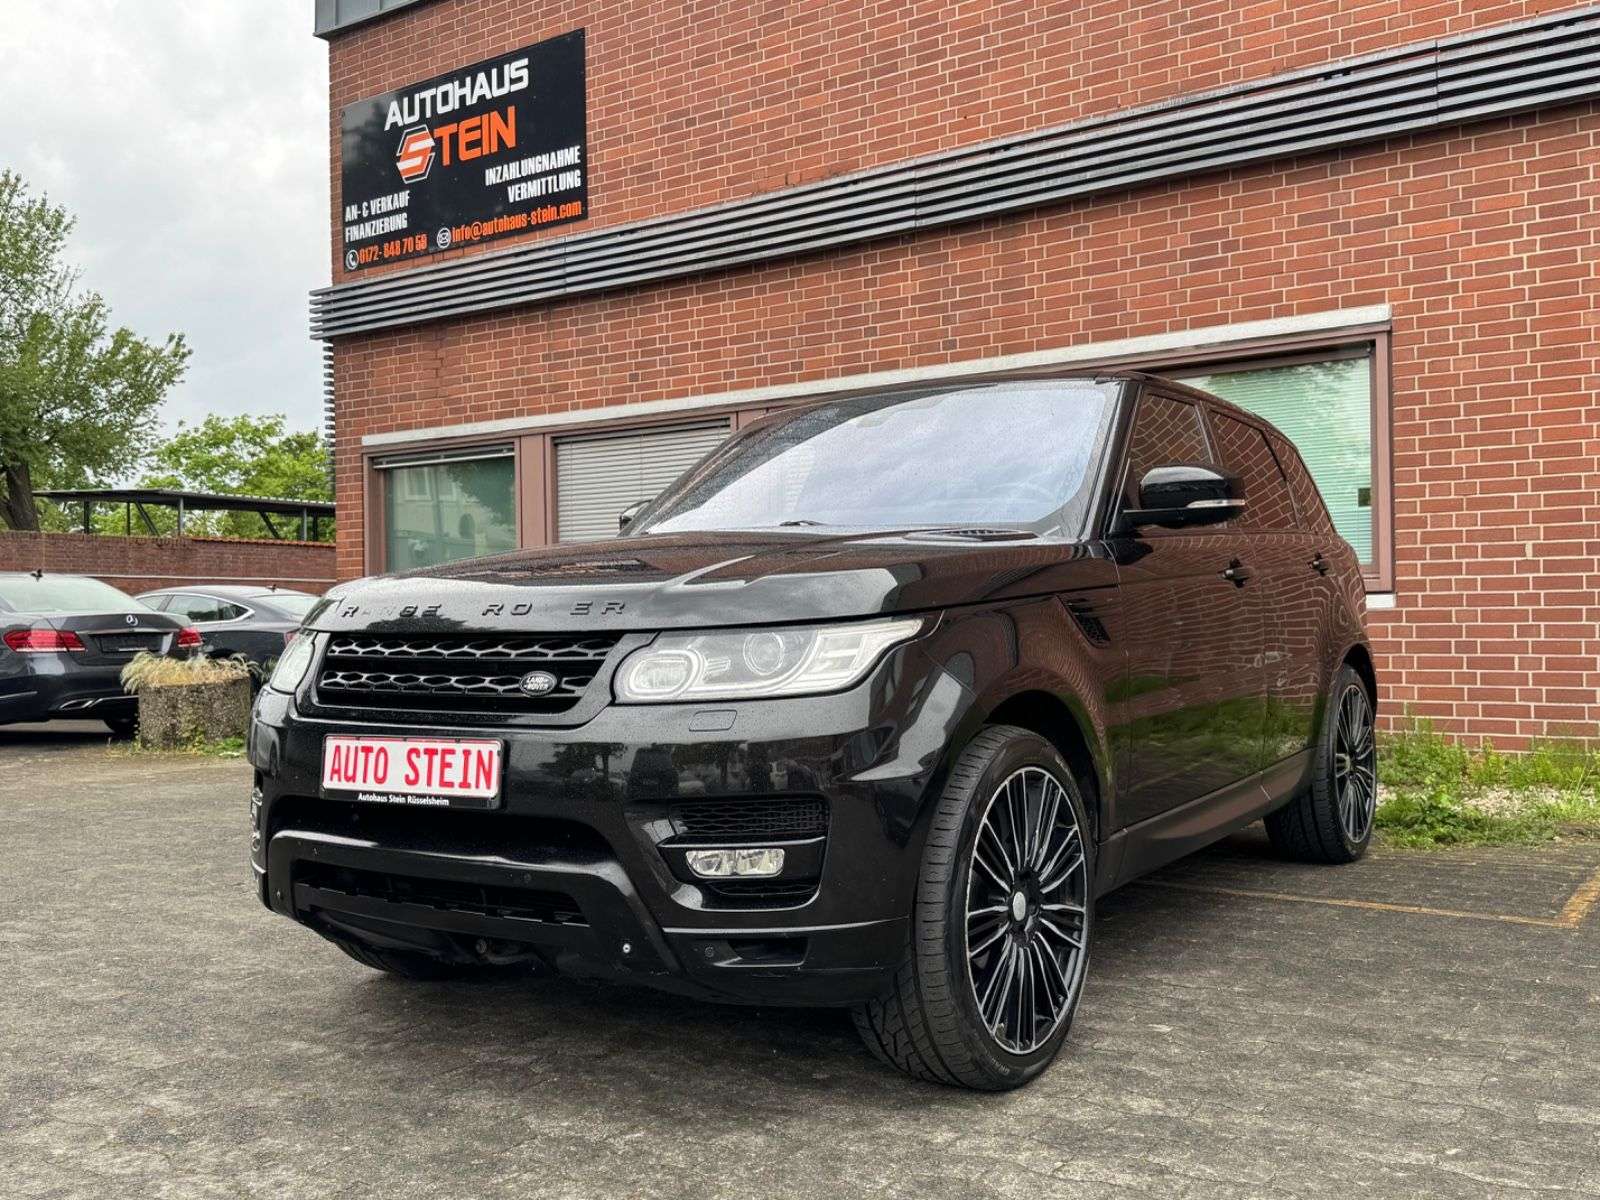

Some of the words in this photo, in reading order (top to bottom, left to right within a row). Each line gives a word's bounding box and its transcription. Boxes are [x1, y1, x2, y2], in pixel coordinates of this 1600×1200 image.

[384, 58, 529, 131] AUTOHAUS
[396, 105, 516, 184] STEIN
[485, 145, 581, 187] INZAHLUNGNAHME
[507, 169, 581, 203] VERMITTLUNG
[345, 204, 361, 222] AN-
[370, 190, 410, 215] VERKAUF
[452, 200, 582, 242] info@autohaus-stein.com
[345, 212, 408, 243] FINANZIERUNG
[402, 237, 414, 255] 70
[482, 601, 625, 616] ROER
[329, 745, 389, 785] AUTO
[404, 747, 494, 790] STEIN
[358, 792, 388, 803] Autohaus
[389, 793, 406, 805] Stein
[407, 794, 450, 806] Rüsselsheim
